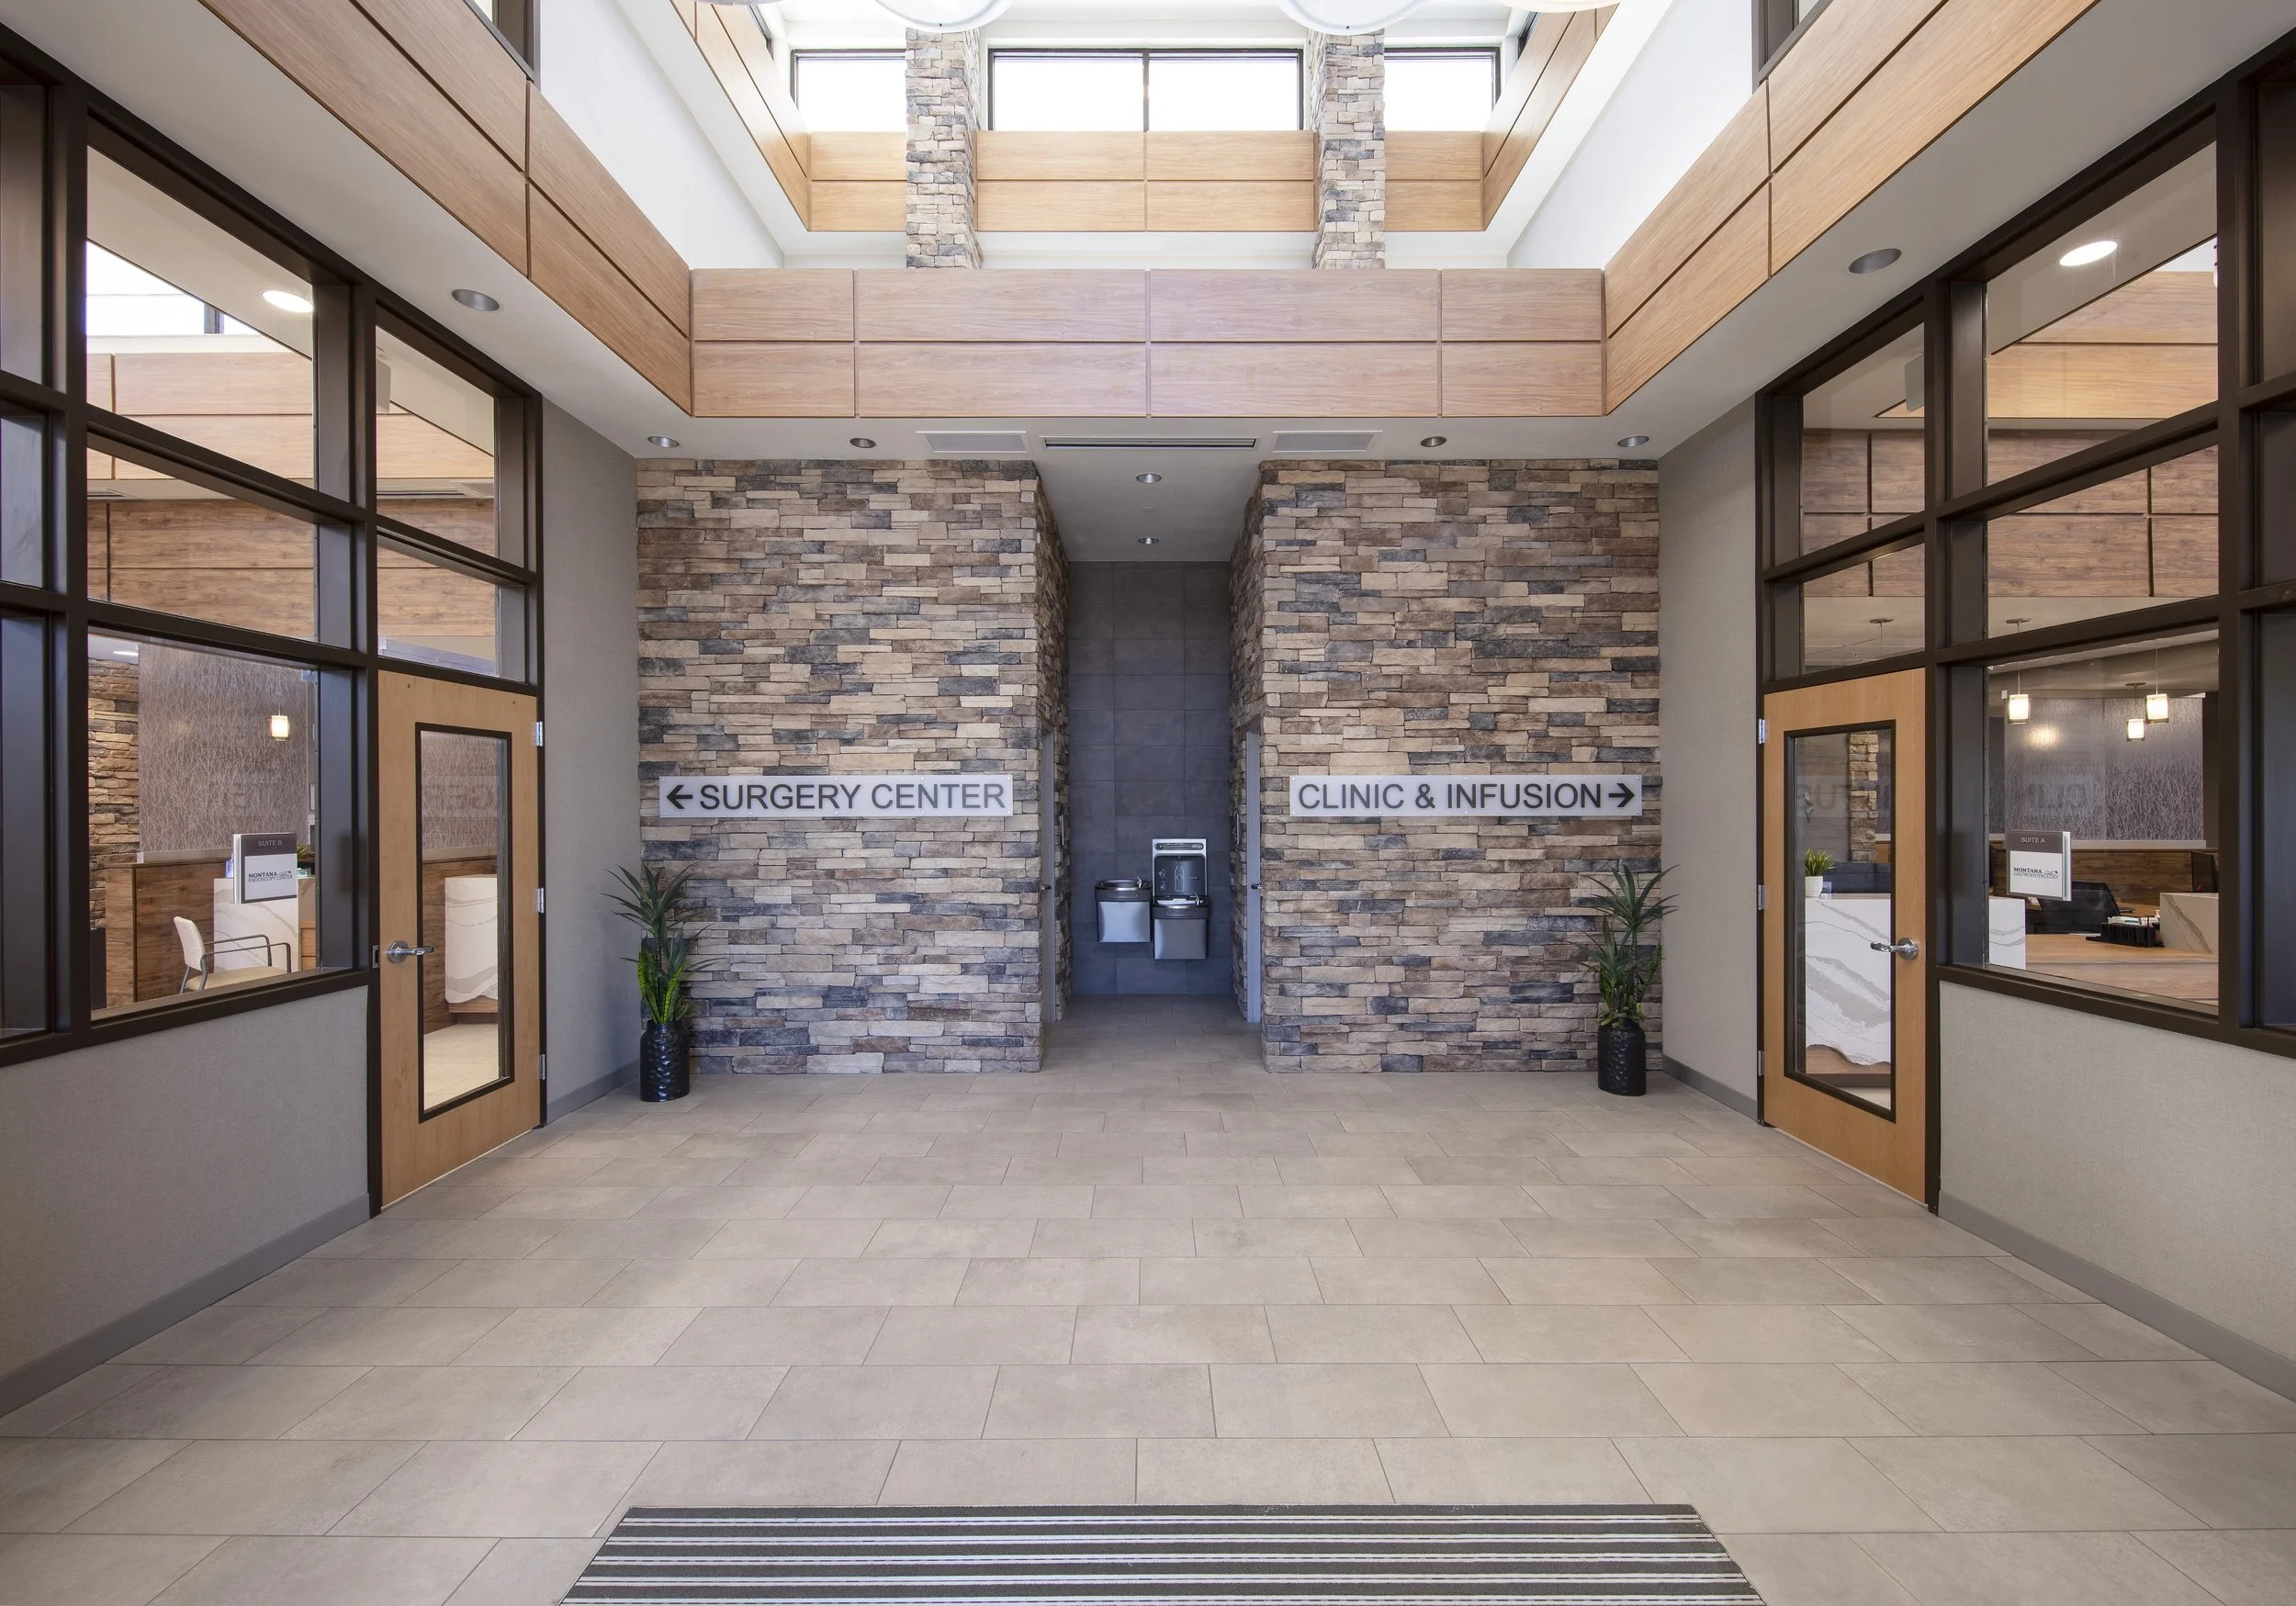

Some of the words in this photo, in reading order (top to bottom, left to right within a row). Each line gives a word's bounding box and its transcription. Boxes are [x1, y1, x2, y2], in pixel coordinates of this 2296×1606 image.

[699, 783, 861, 810] SURGERY
[871, 783, 1006, 809] CENTER
[1298, 782, 1404, 809] CLINIC
[1415, 783, 1435, 809] &
[1447, 782, 1602, 809] INFUSION
